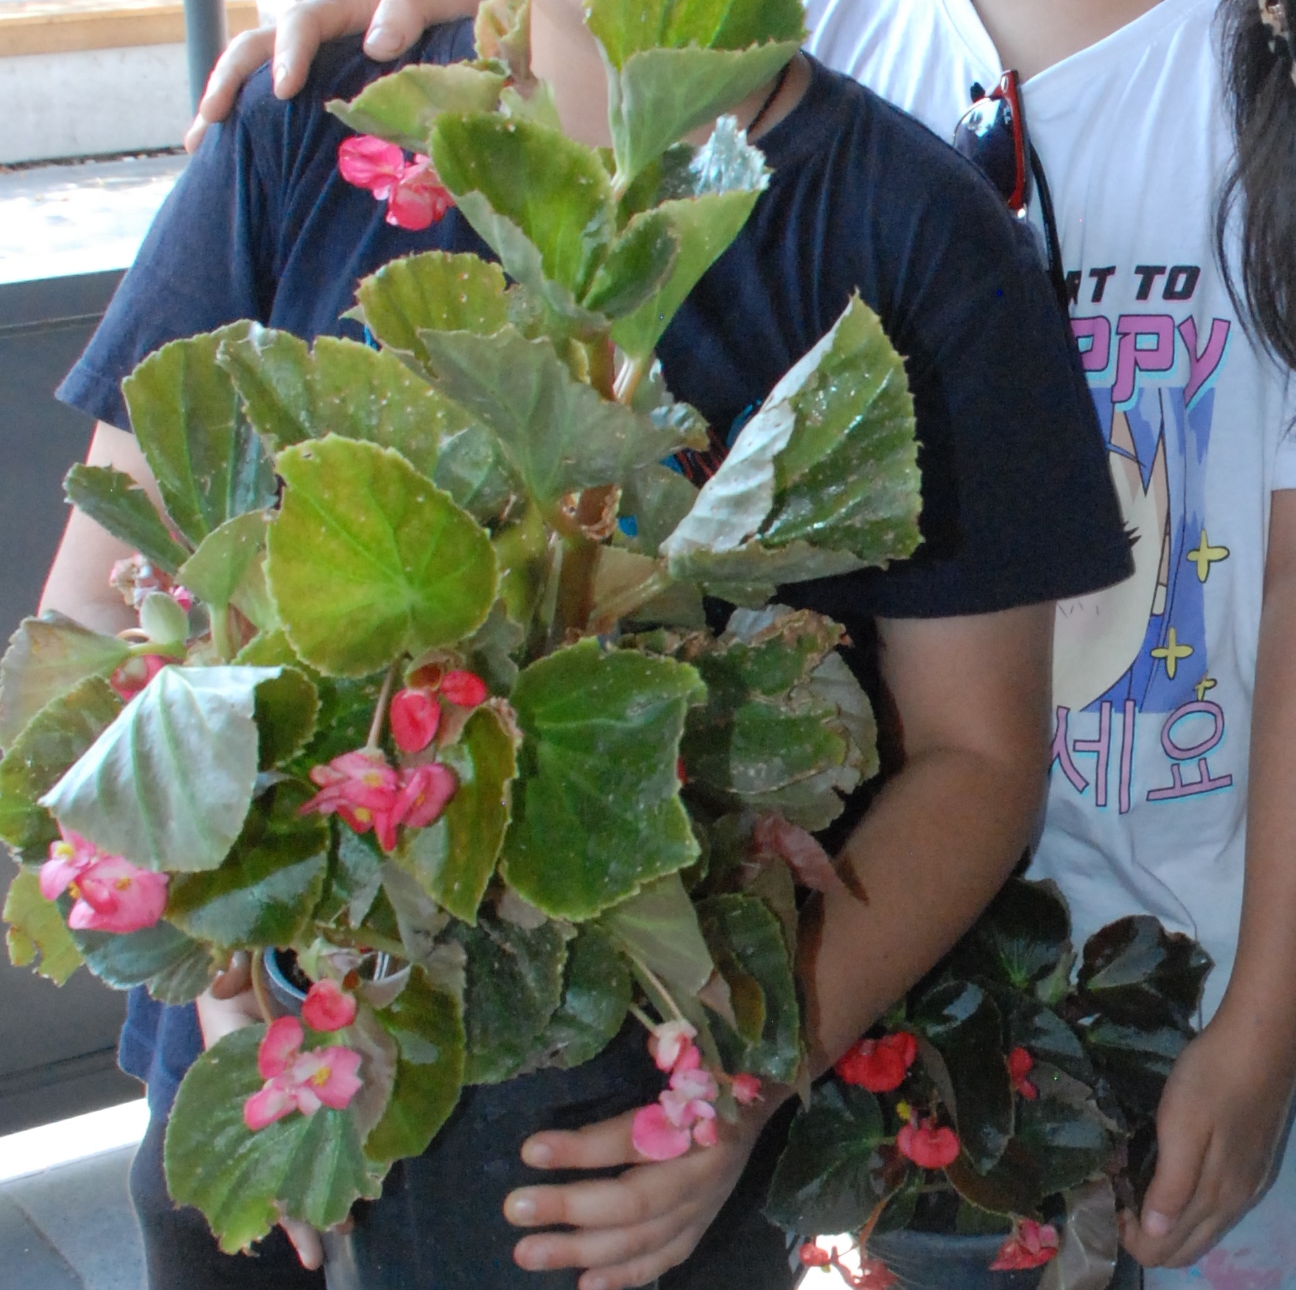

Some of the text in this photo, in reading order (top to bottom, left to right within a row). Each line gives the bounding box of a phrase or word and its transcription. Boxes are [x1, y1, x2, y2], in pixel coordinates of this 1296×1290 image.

[1065, 264, 1202, 304] AT TO
[1070, 313, 1232, 407] ppy
[1050, 698, 1232, 815] 세요
